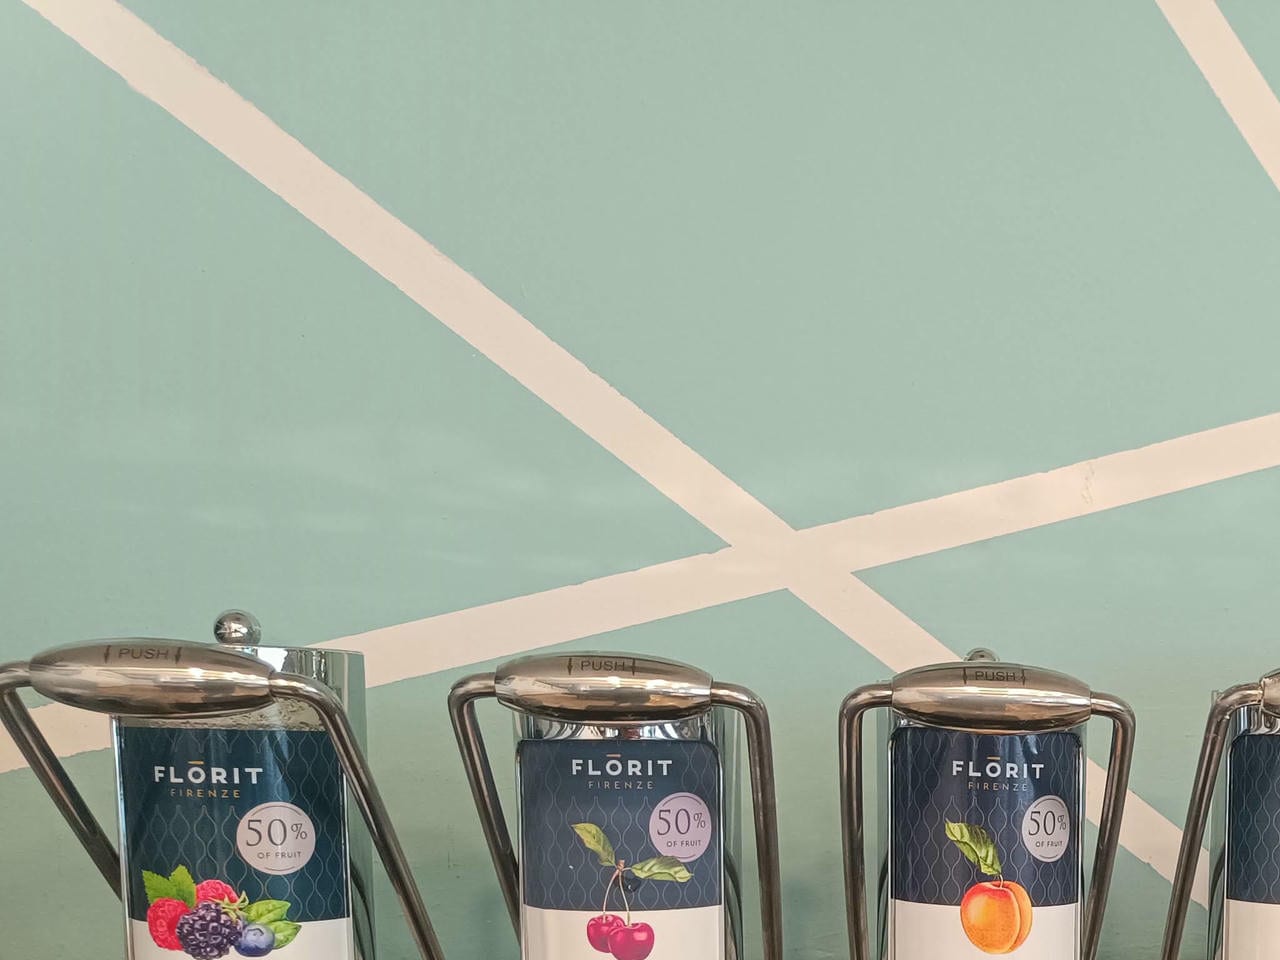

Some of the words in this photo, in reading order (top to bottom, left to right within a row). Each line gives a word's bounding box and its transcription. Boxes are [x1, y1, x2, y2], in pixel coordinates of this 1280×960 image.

[118, 648, 169, 659] PUSH
[580, 660, 625, 671] PUSH
[975, 671, 1016, 681] PUSH
[588, 781, 655, 790] FIRENZE
[968, 781, 1028, 792] FIRENZE
[170, 788, 241, 798] FIRENZE
[657, 808, 706, 836] 50%
[1028, 810, 1067, 836] 50%
[246, 818, 308, 847] 50%
[680, 840, 702, 848] FRUIT
[257, 851, 271, 860] OF
[275, 851, 302, 860] FRUIT
